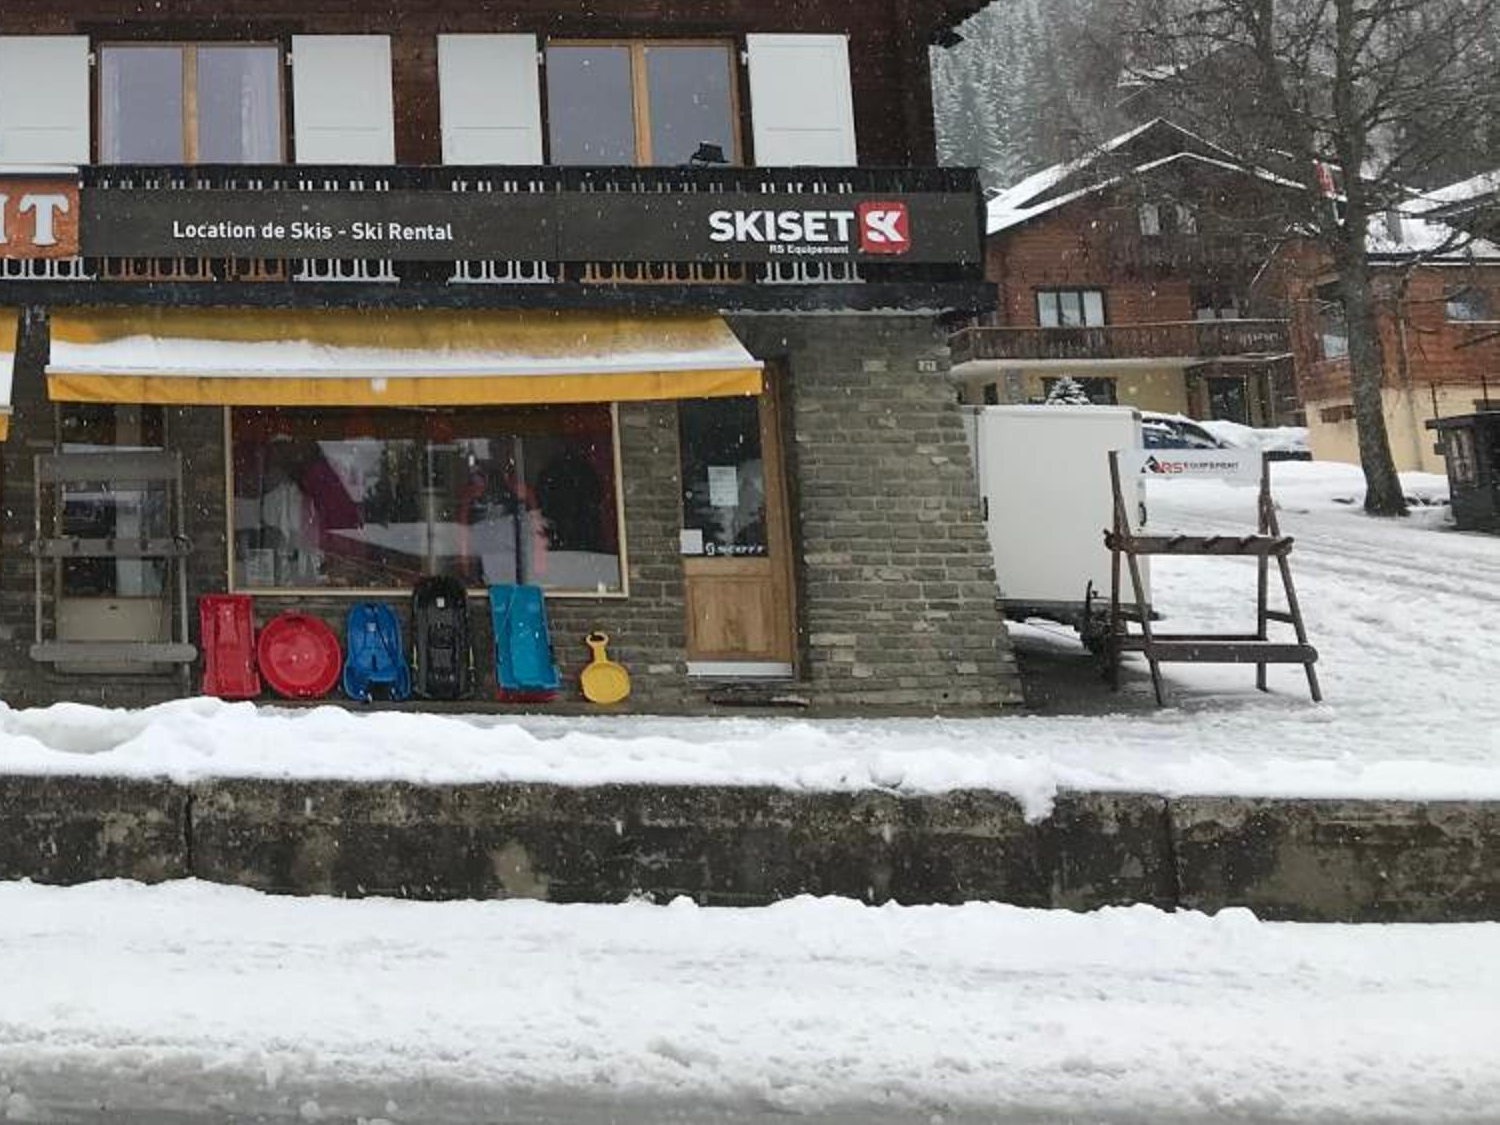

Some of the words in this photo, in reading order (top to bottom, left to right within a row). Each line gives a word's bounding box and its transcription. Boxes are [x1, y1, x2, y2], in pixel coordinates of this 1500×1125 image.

[172, 220, 256, 239] Location
[261, 221, 286, 239] de
[290, 222, 334, 240] Skis
[352, 222, 384, 241] Ski
[388, 223, 454, 241] Rental
[707, 210, 856, 242] SKISET
[769, 244, 785, 255] RS
[787, 244, 850, 255] Equipement
